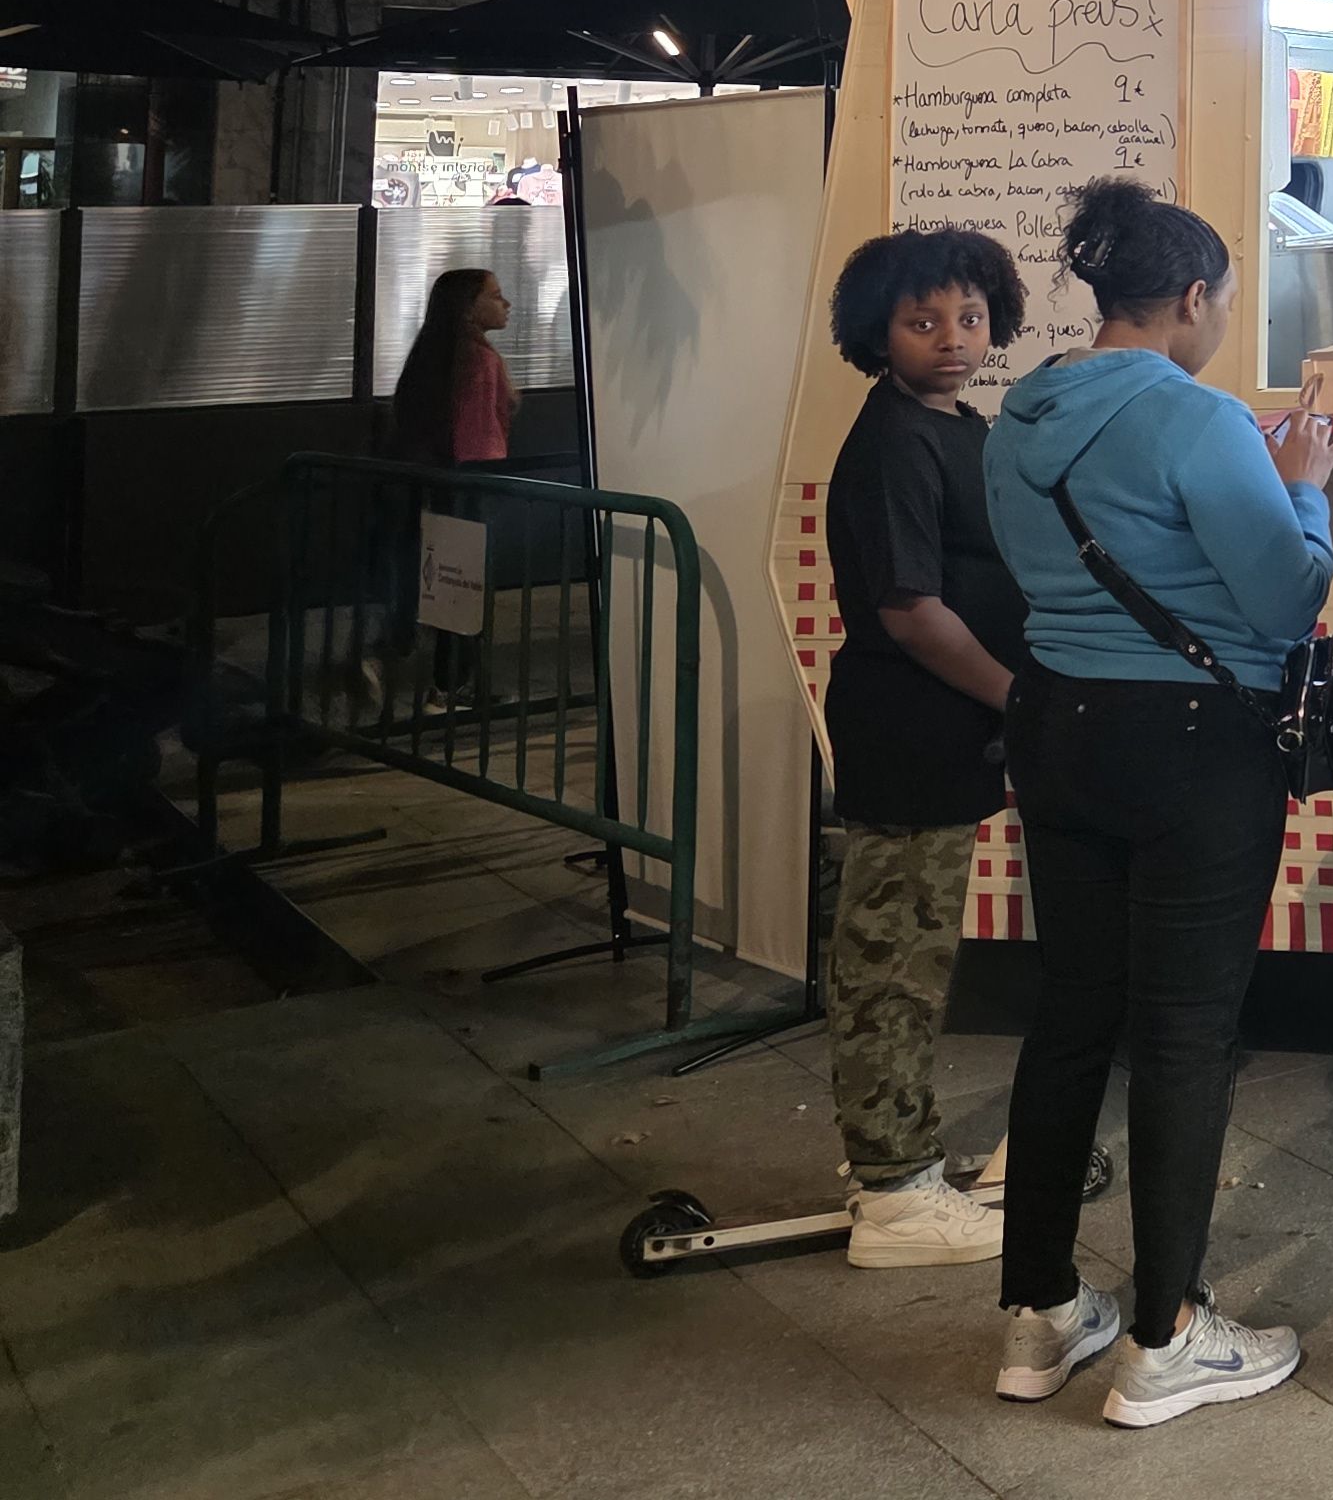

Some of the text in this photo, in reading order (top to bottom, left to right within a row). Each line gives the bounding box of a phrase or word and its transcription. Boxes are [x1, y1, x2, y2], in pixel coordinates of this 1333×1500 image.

[1006, 83, 1071, 113] completa
[1008, 149, 1028, 170] La
[1031, 149, 1074, 169] Cabra
[937, 182, 953, 198] de
[1016, 210, 1065, 239] Pulled
